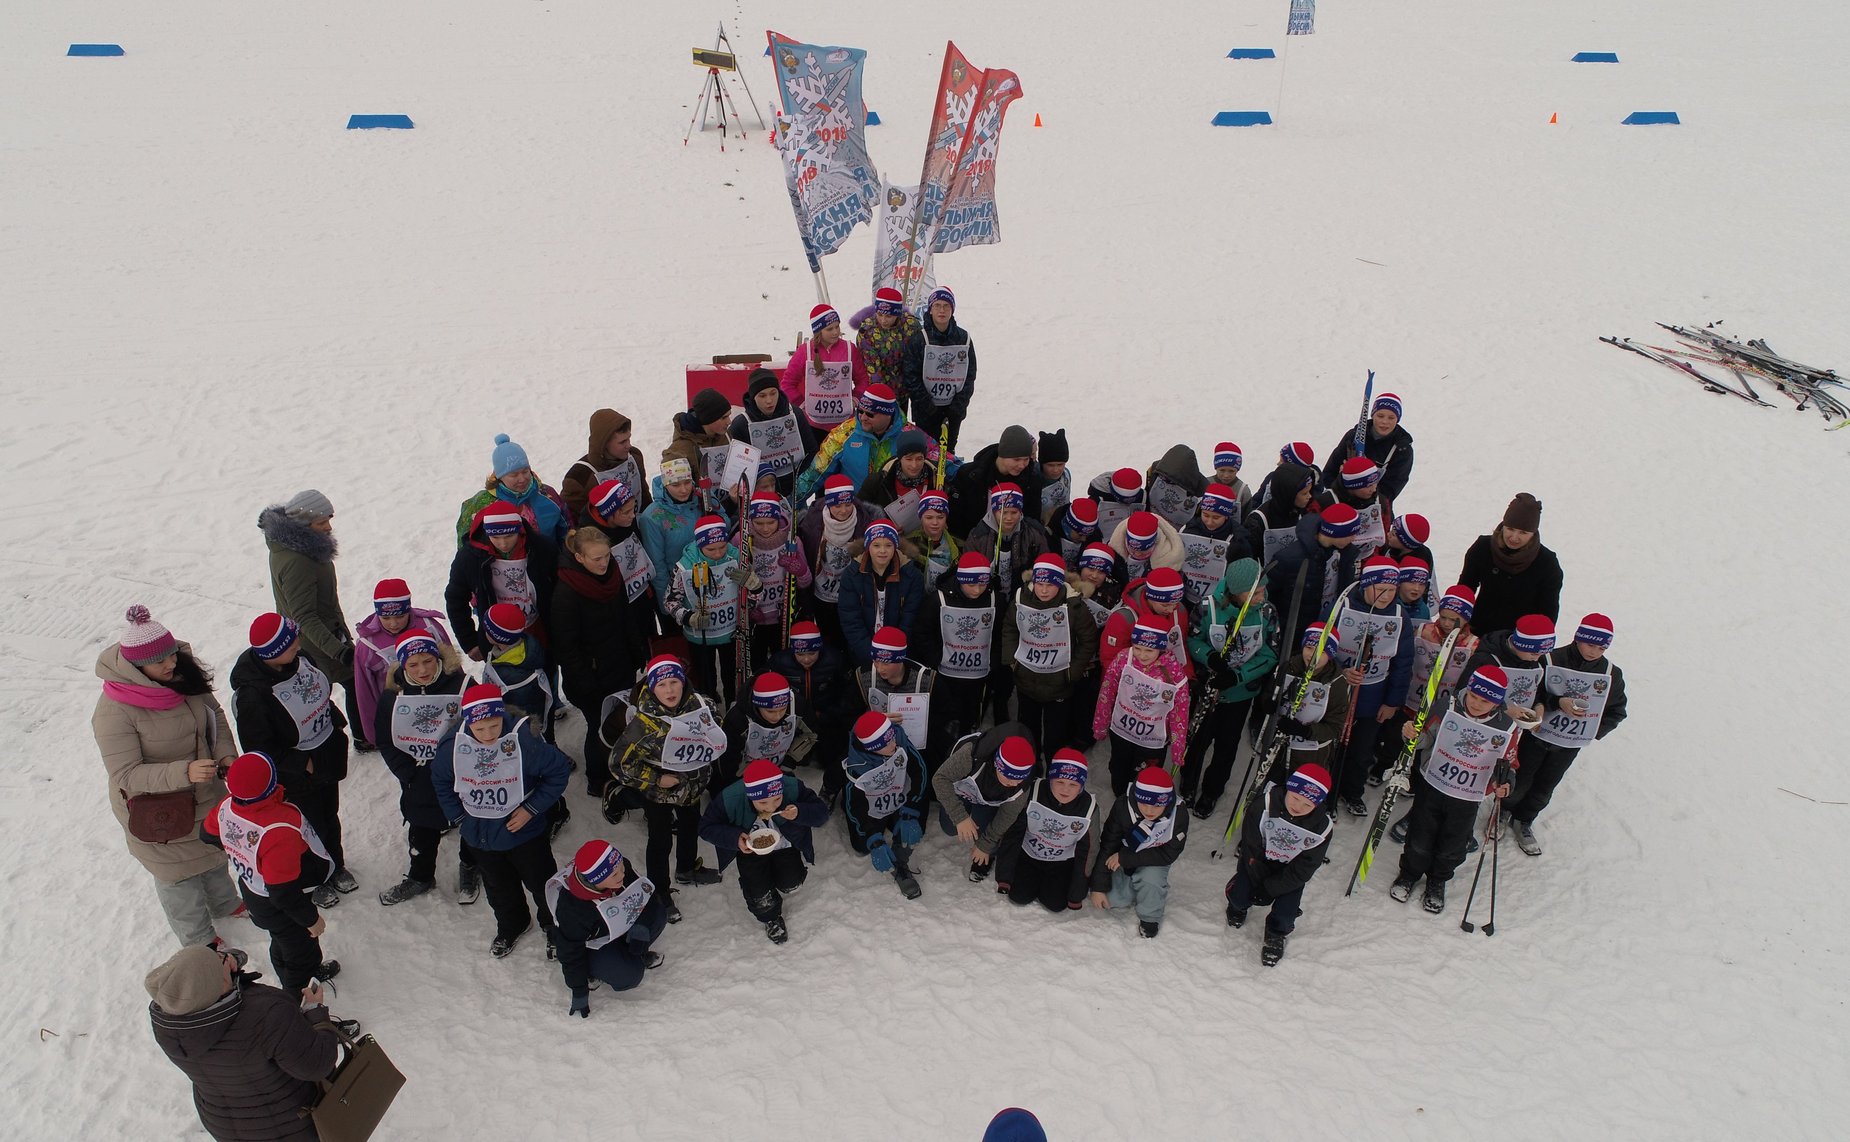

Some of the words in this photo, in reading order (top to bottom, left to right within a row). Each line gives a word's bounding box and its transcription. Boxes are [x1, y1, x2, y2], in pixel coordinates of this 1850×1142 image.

[816, 127, 848, 143] 018
[946, 146, 958, 163] 20
[966, 160, 992, 176] 218
[796, 166, 818, 193] 018
[814, 400, 844, 414] 4993
[1185, 580, 1211, 596] 957
[710, 607, 734, 626] 988
[949, 651, 982, 667] 4968
[1026, 648, 1058, 665] 4977
[301, 711, 318, 726] ЛЫЖНЯ
[1120, 714, 1154, 736] 4907
[1549, 714, 1587, 735] 4921
[1408, 711, 1426, 754] ACIVE
[674, 744, 714, 762] 4928
[1438, 748, 1455, 762] ЛЫЖНЯ
[1456, 760, 1478, 770] РОССИИ
[1439, 762, 1478, 788] 4901
[228, 854, 253, 884] 929
